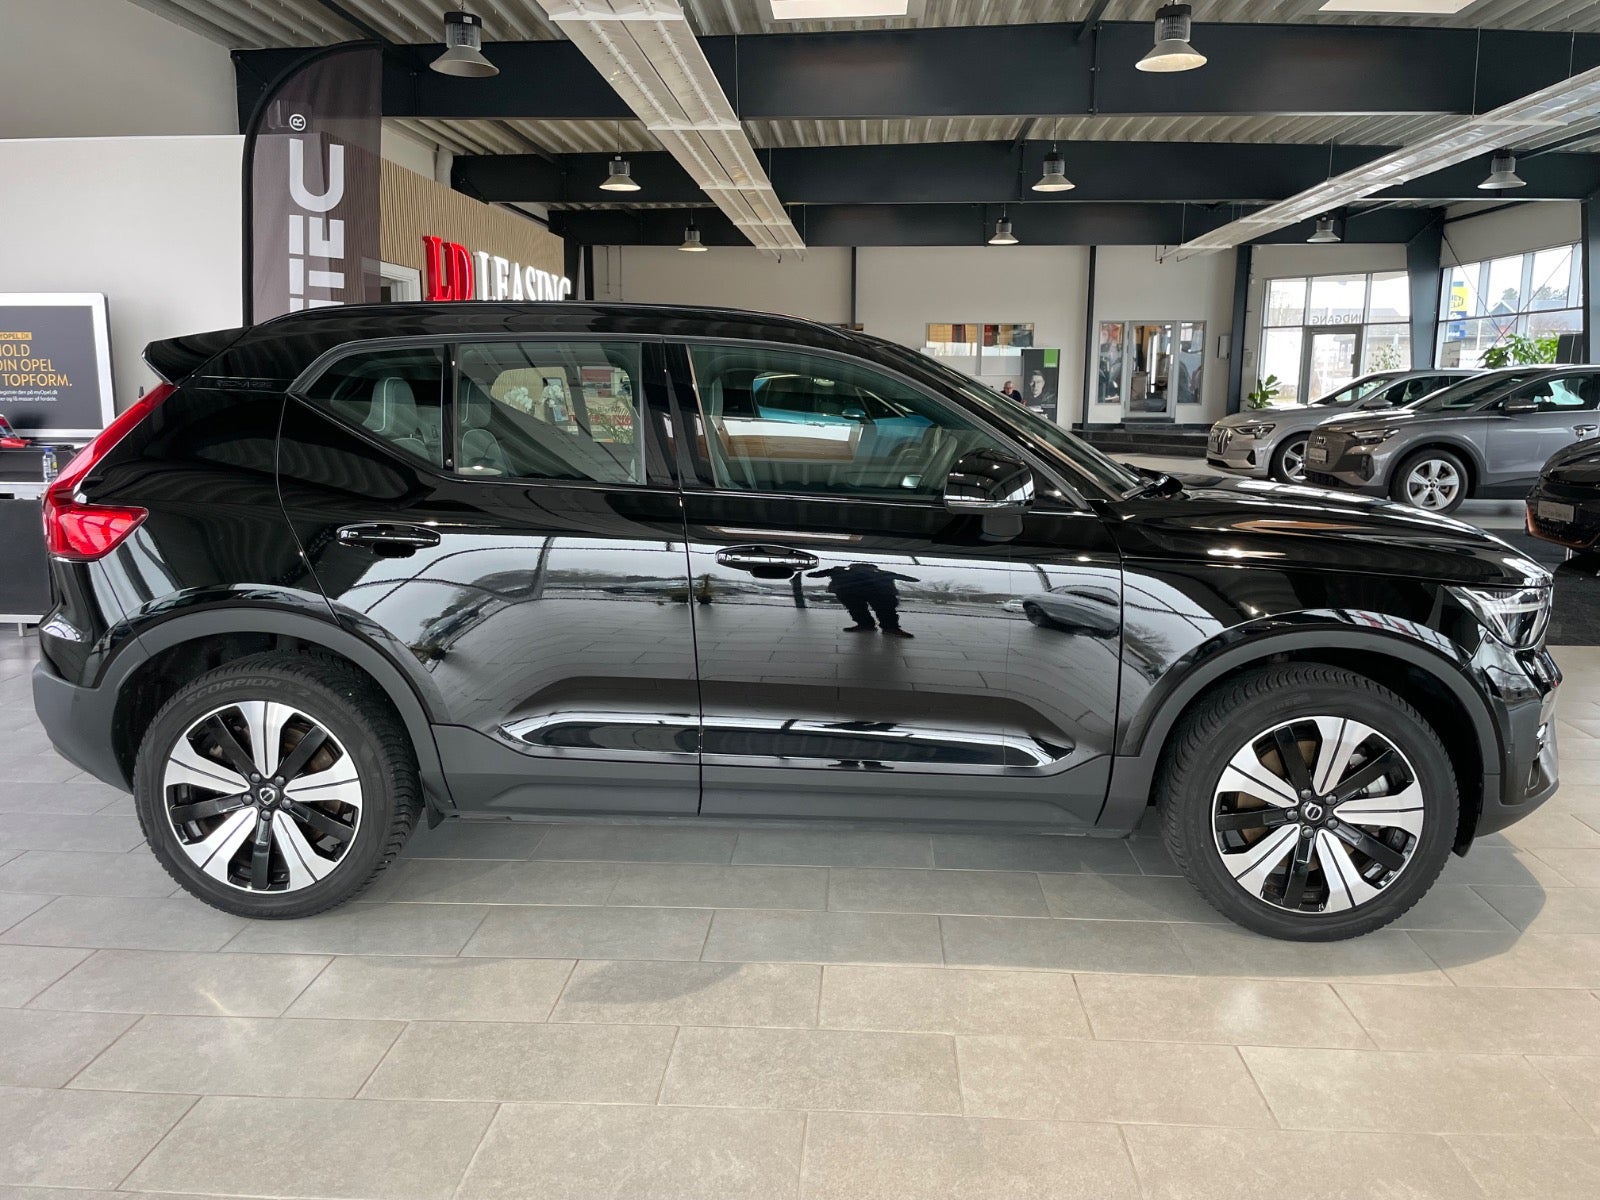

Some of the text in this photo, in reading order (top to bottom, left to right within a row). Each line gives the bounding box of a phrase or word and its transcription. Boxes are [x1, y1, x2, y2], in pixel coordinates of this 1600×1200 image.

[422, 235, 473, 301] LD
[0, 344, 30, 356] OLD
[20, 358, 56, 372] OPEL
[2, 373, 72, 387] TOPFORM.
[185, 678, 283, 706] SCORPION
